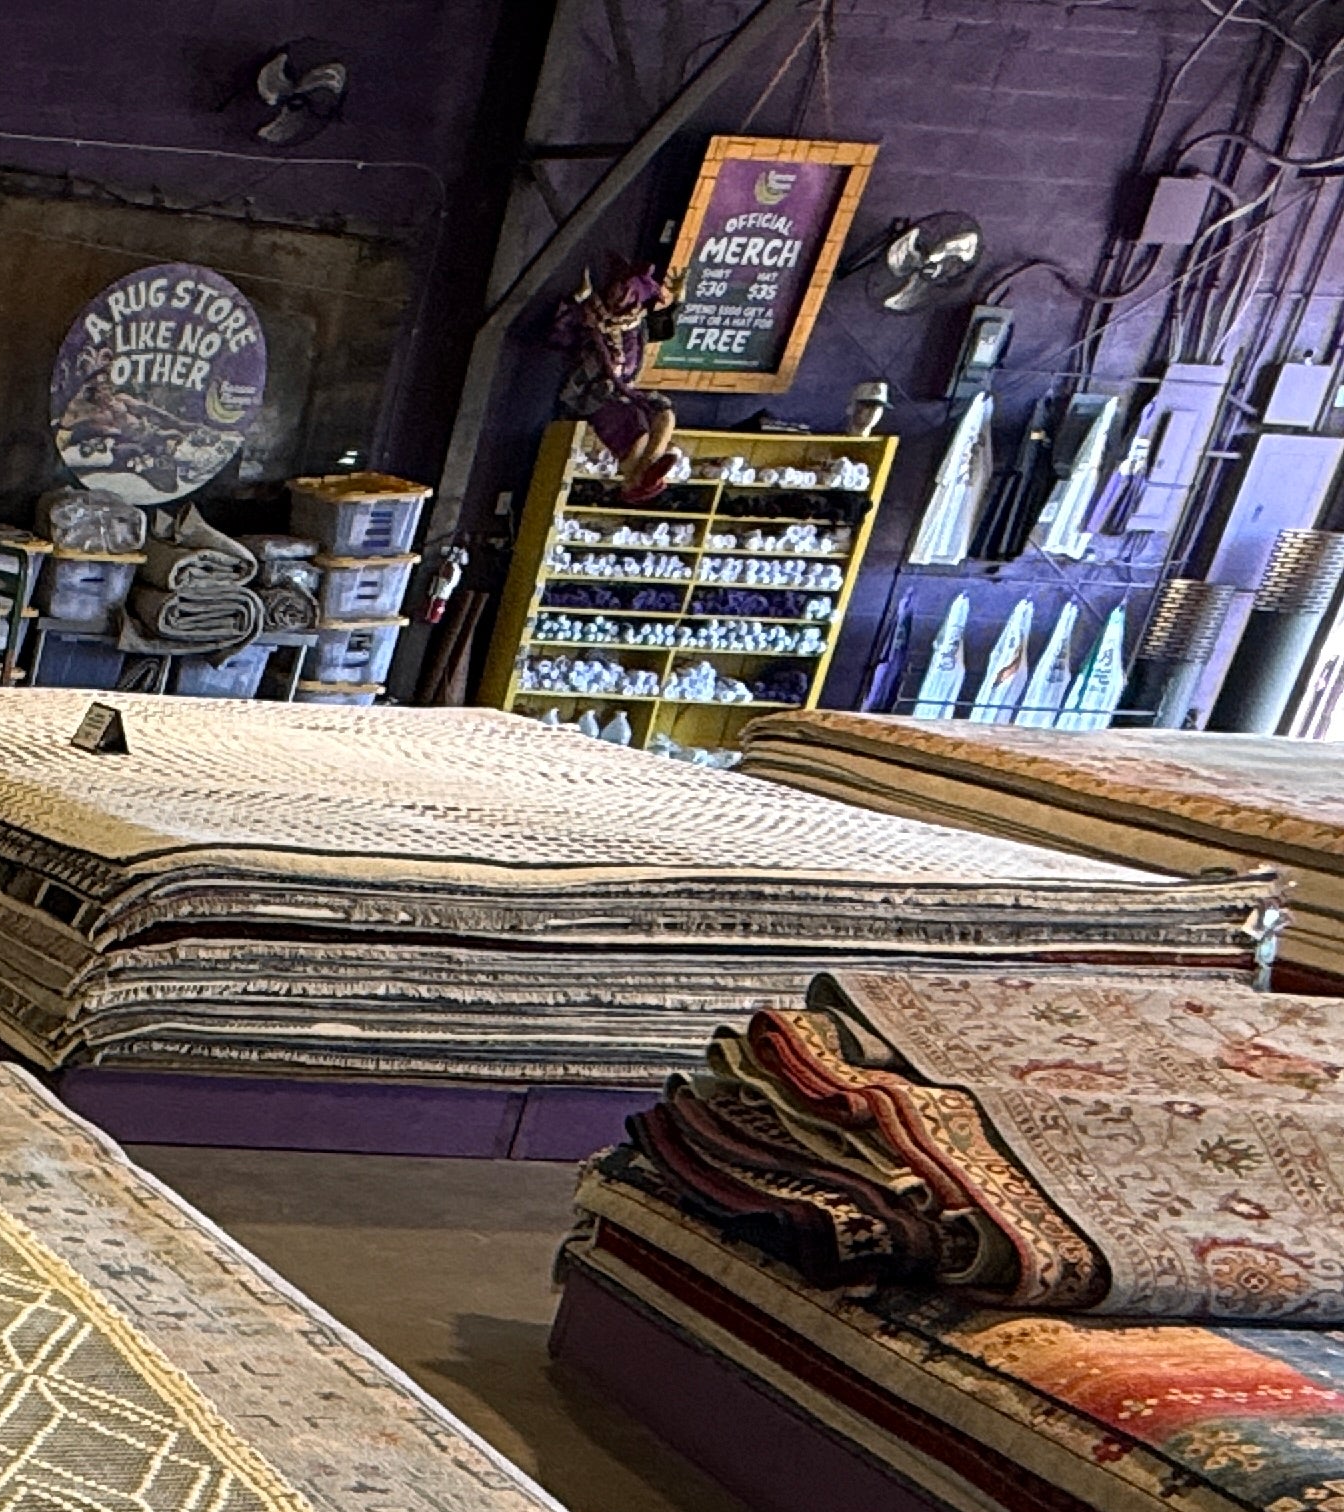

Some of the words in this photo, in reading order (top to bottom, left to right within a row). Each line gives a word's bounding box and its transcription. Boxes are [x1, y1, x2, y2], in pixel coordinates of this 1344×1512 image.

[725, 212, 795, 236] OFFICIAL
[699, 237, 803, 268] MERCH
[696, 280, 728, 298] $30
[746, 282, 779, 301] $35
[84, 312, 112, 344] A
[108, 278, 168, 322] RUG
[170, 280, 258, 353] STORE
[115, 321, 177, 353] LIKE
[178, 323, 222, 360] NO
[686, 327, 752, 354] FREE
[111, 354, 211, 392] OTHER
